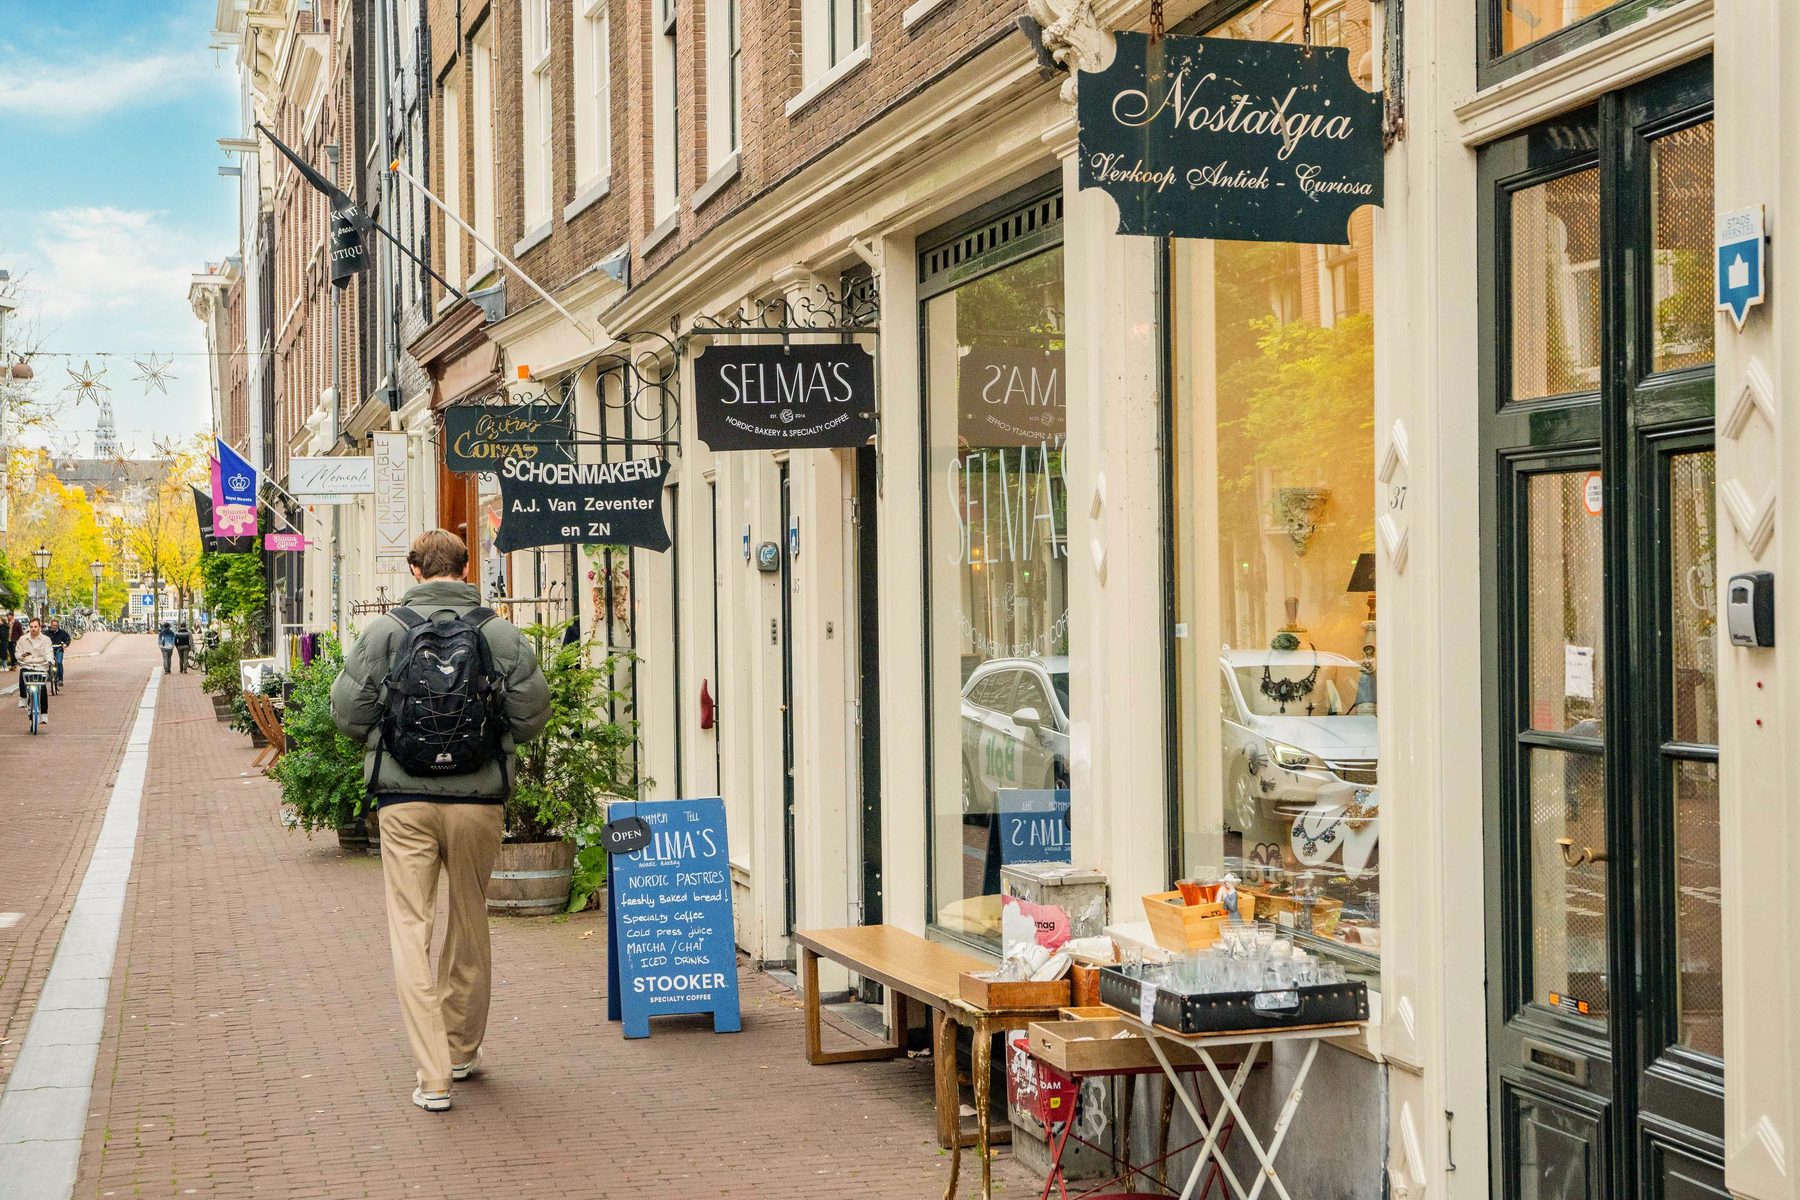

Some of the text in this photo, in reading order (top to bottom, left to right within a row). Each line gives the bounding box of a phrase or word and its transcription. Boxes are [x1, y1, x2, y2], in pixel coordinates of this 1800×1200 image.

[1112, 73, 1353, 160] Nostalgia
[1091, 153, 1177, 191] Verkoop
[1187, 161, 1269, 190] Antiek
[1296, 164, 1373, 195] Curiosa
[720, 362, 853, 404] SELMA'S
[725, 415, 754, 432] NORDIC
[755, 427, 780, 437] BAKERY
[789, 424, 823, 437] SPECIALTY
[824, 412, 849, 430] COFFEE
[377, 438, 390, 524] INJECTABLE
[502, 457, 662, 485] SCHOENMAKERIJ
[392, 461, 406, 523] KLINIEK
[1391, 486, 1407, 510] 37
[512, 497, 654, 512] A.J. Van Zeventer
[561, 523, 611, 536] en ZN
[611, 829, 642, 842] OPEN
[629, 874, 669, 889] NORDIC
[656, 929, 682, 938] press
[688, 926, 713, 938] juice
[626, 942, 667, 955] MATCHA
[641, 956, 667, 968] ICED
[633, 972, 726, 993] STOOKER
[649, 993, 712, 1003] SPECIALTY COFFEE
